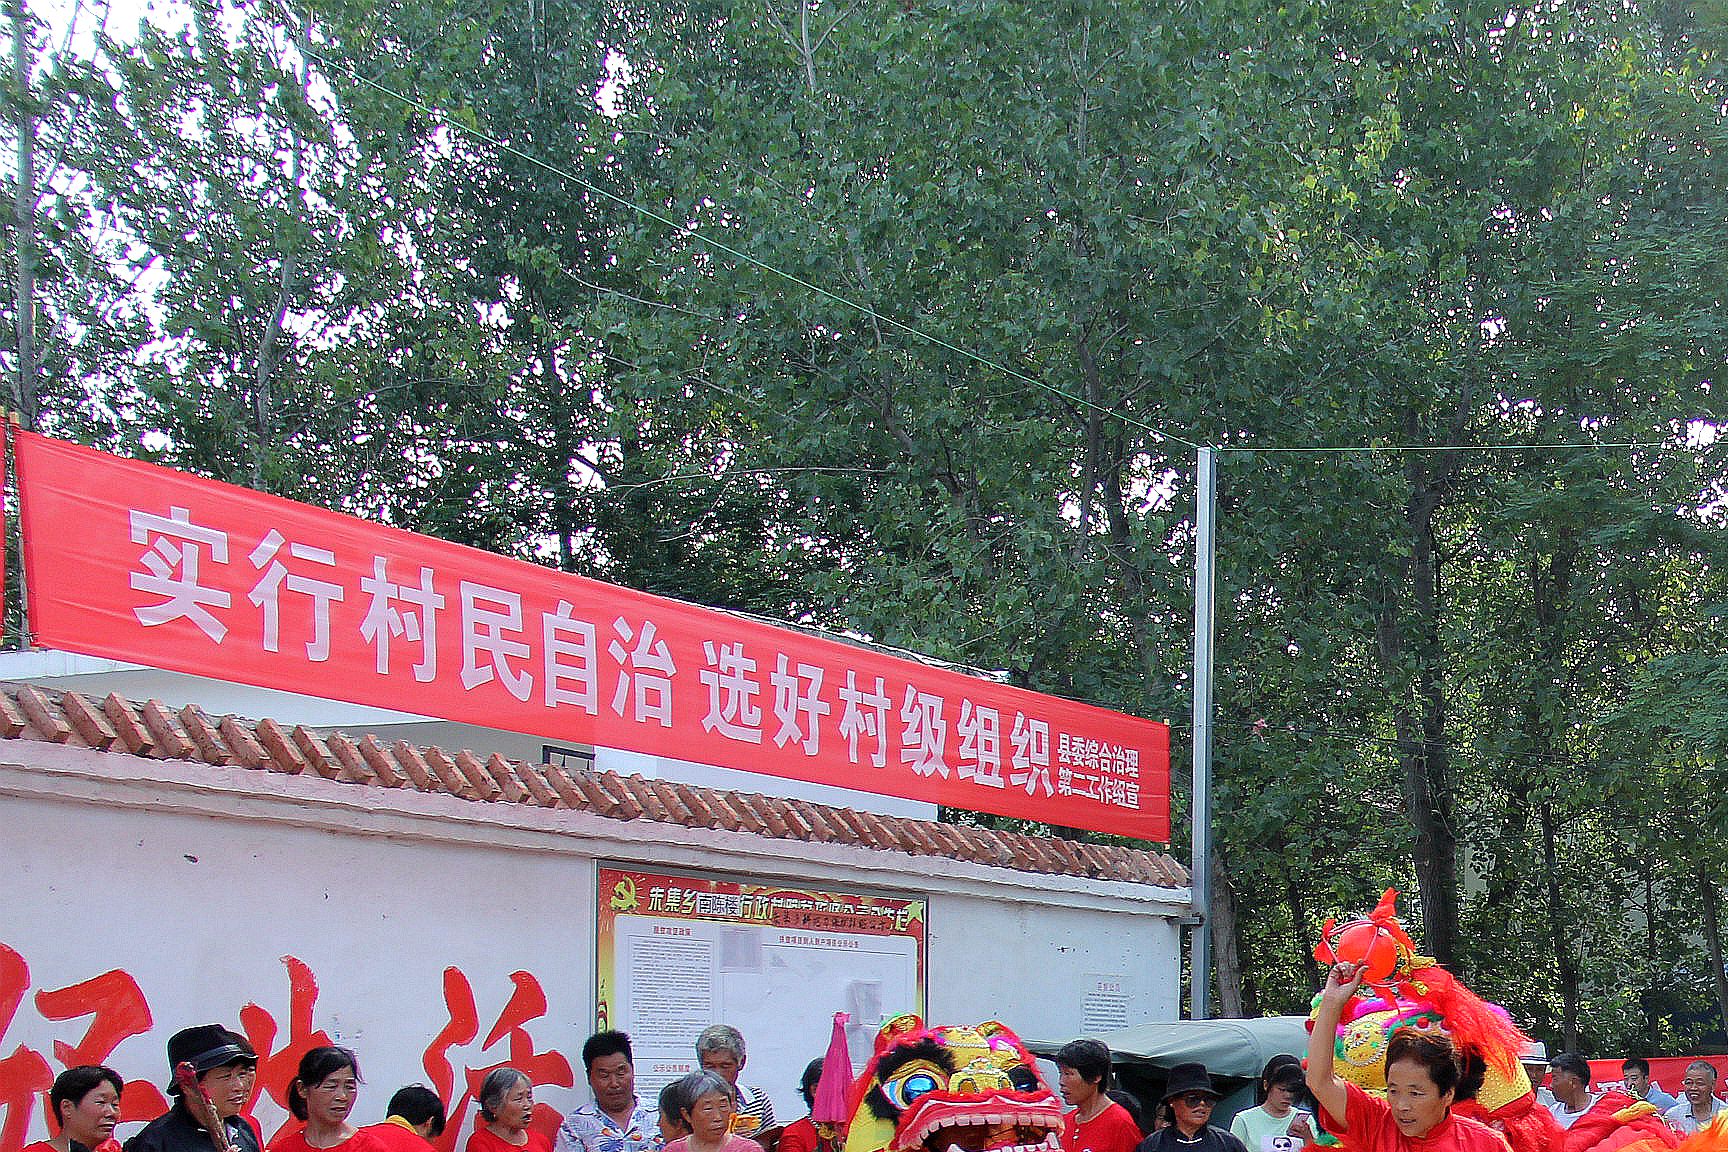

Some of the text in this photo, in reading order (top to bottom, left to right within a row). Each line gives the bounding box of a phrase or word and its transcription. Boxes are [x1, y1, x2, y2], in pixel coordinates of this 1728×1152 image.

[129, 506, 1055, 798] 实行村民自治 选好村级组织
[1057, 732, 1140, 778] 县委综合治理
[1057, 766, 1141, 810] 第二工作组宣
